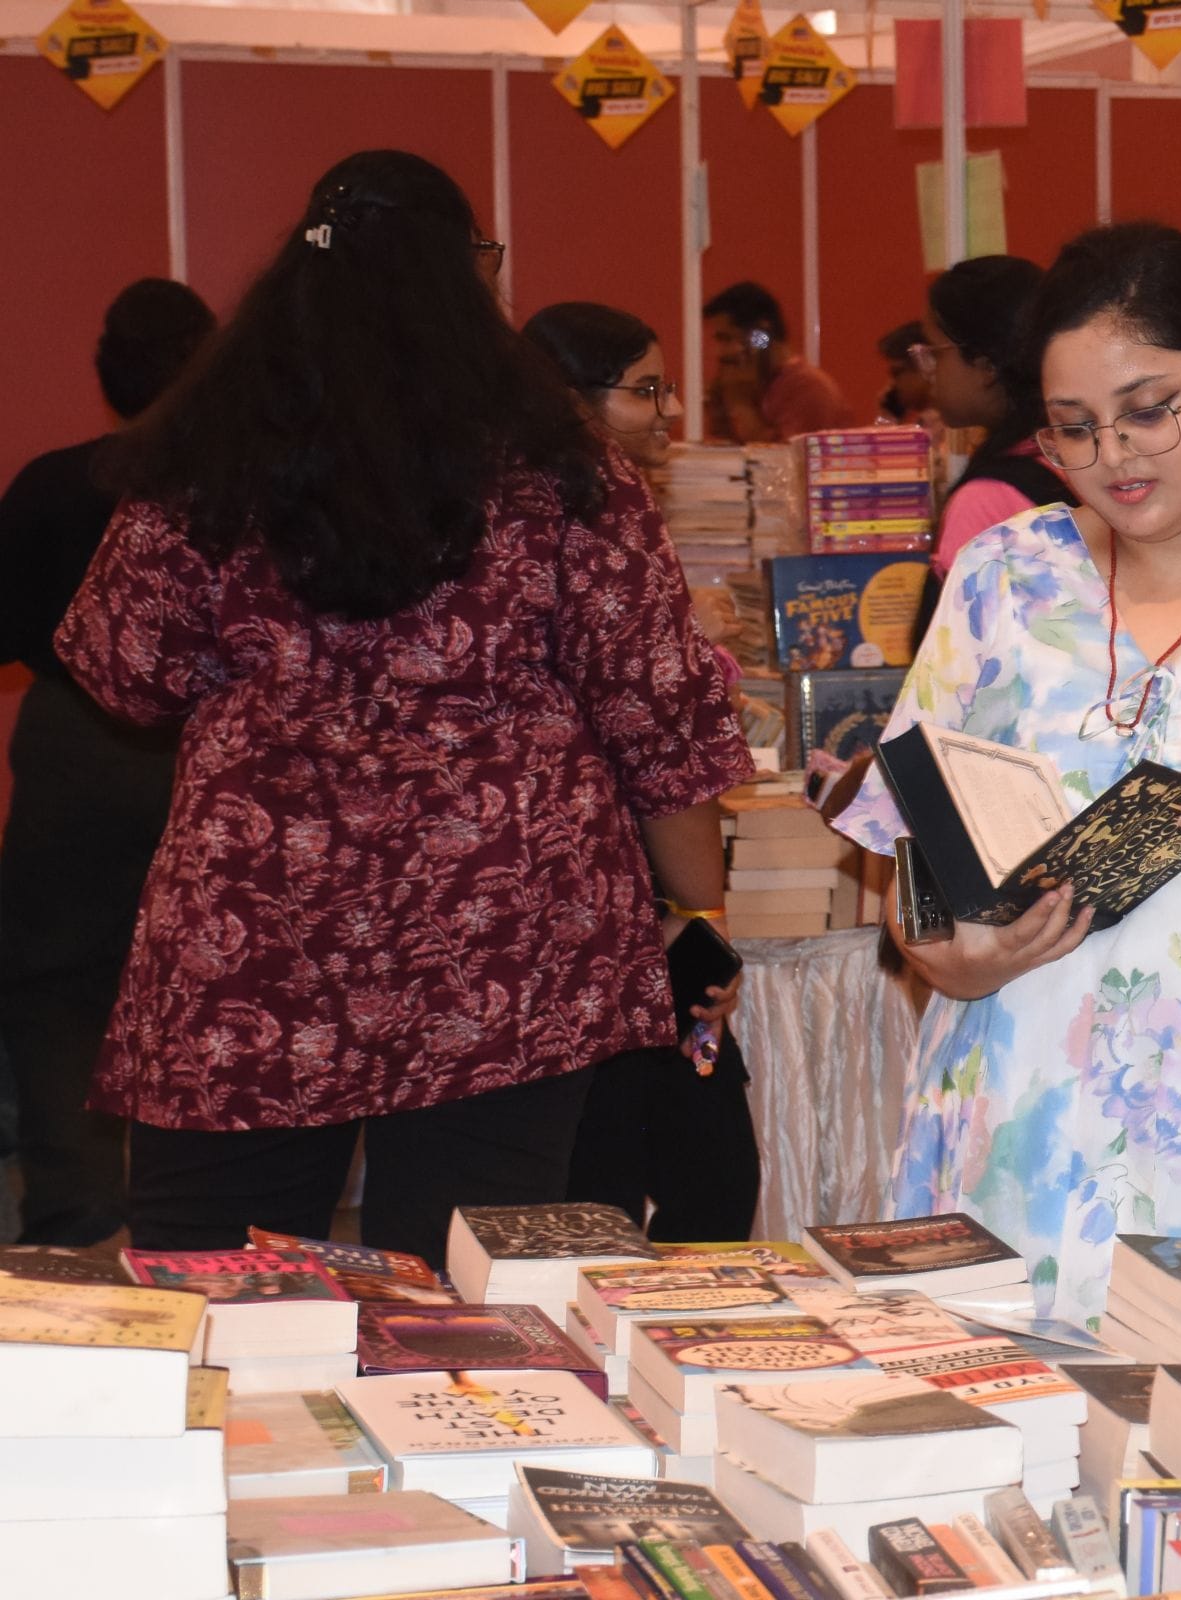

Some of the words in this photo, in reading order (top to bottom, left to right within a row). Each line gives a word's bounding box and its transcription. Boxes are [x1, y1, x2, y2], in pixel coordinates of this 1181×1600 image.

[785, 591, 858, 618] FAMOUS
[1089, 822, 1180, 895] KINGDO
[410, 1389, 535, 1400] YEAR
[396, 1399, 478, 1408] THE
[506, 1396, 560, 1405] OF
[414, 1408, 566, 1421] DEATH
[445, 1418, 555, 1429] LAST
[461, 1428, 552, 1438] THE
[583, 1482, 658, 1495] MAN
